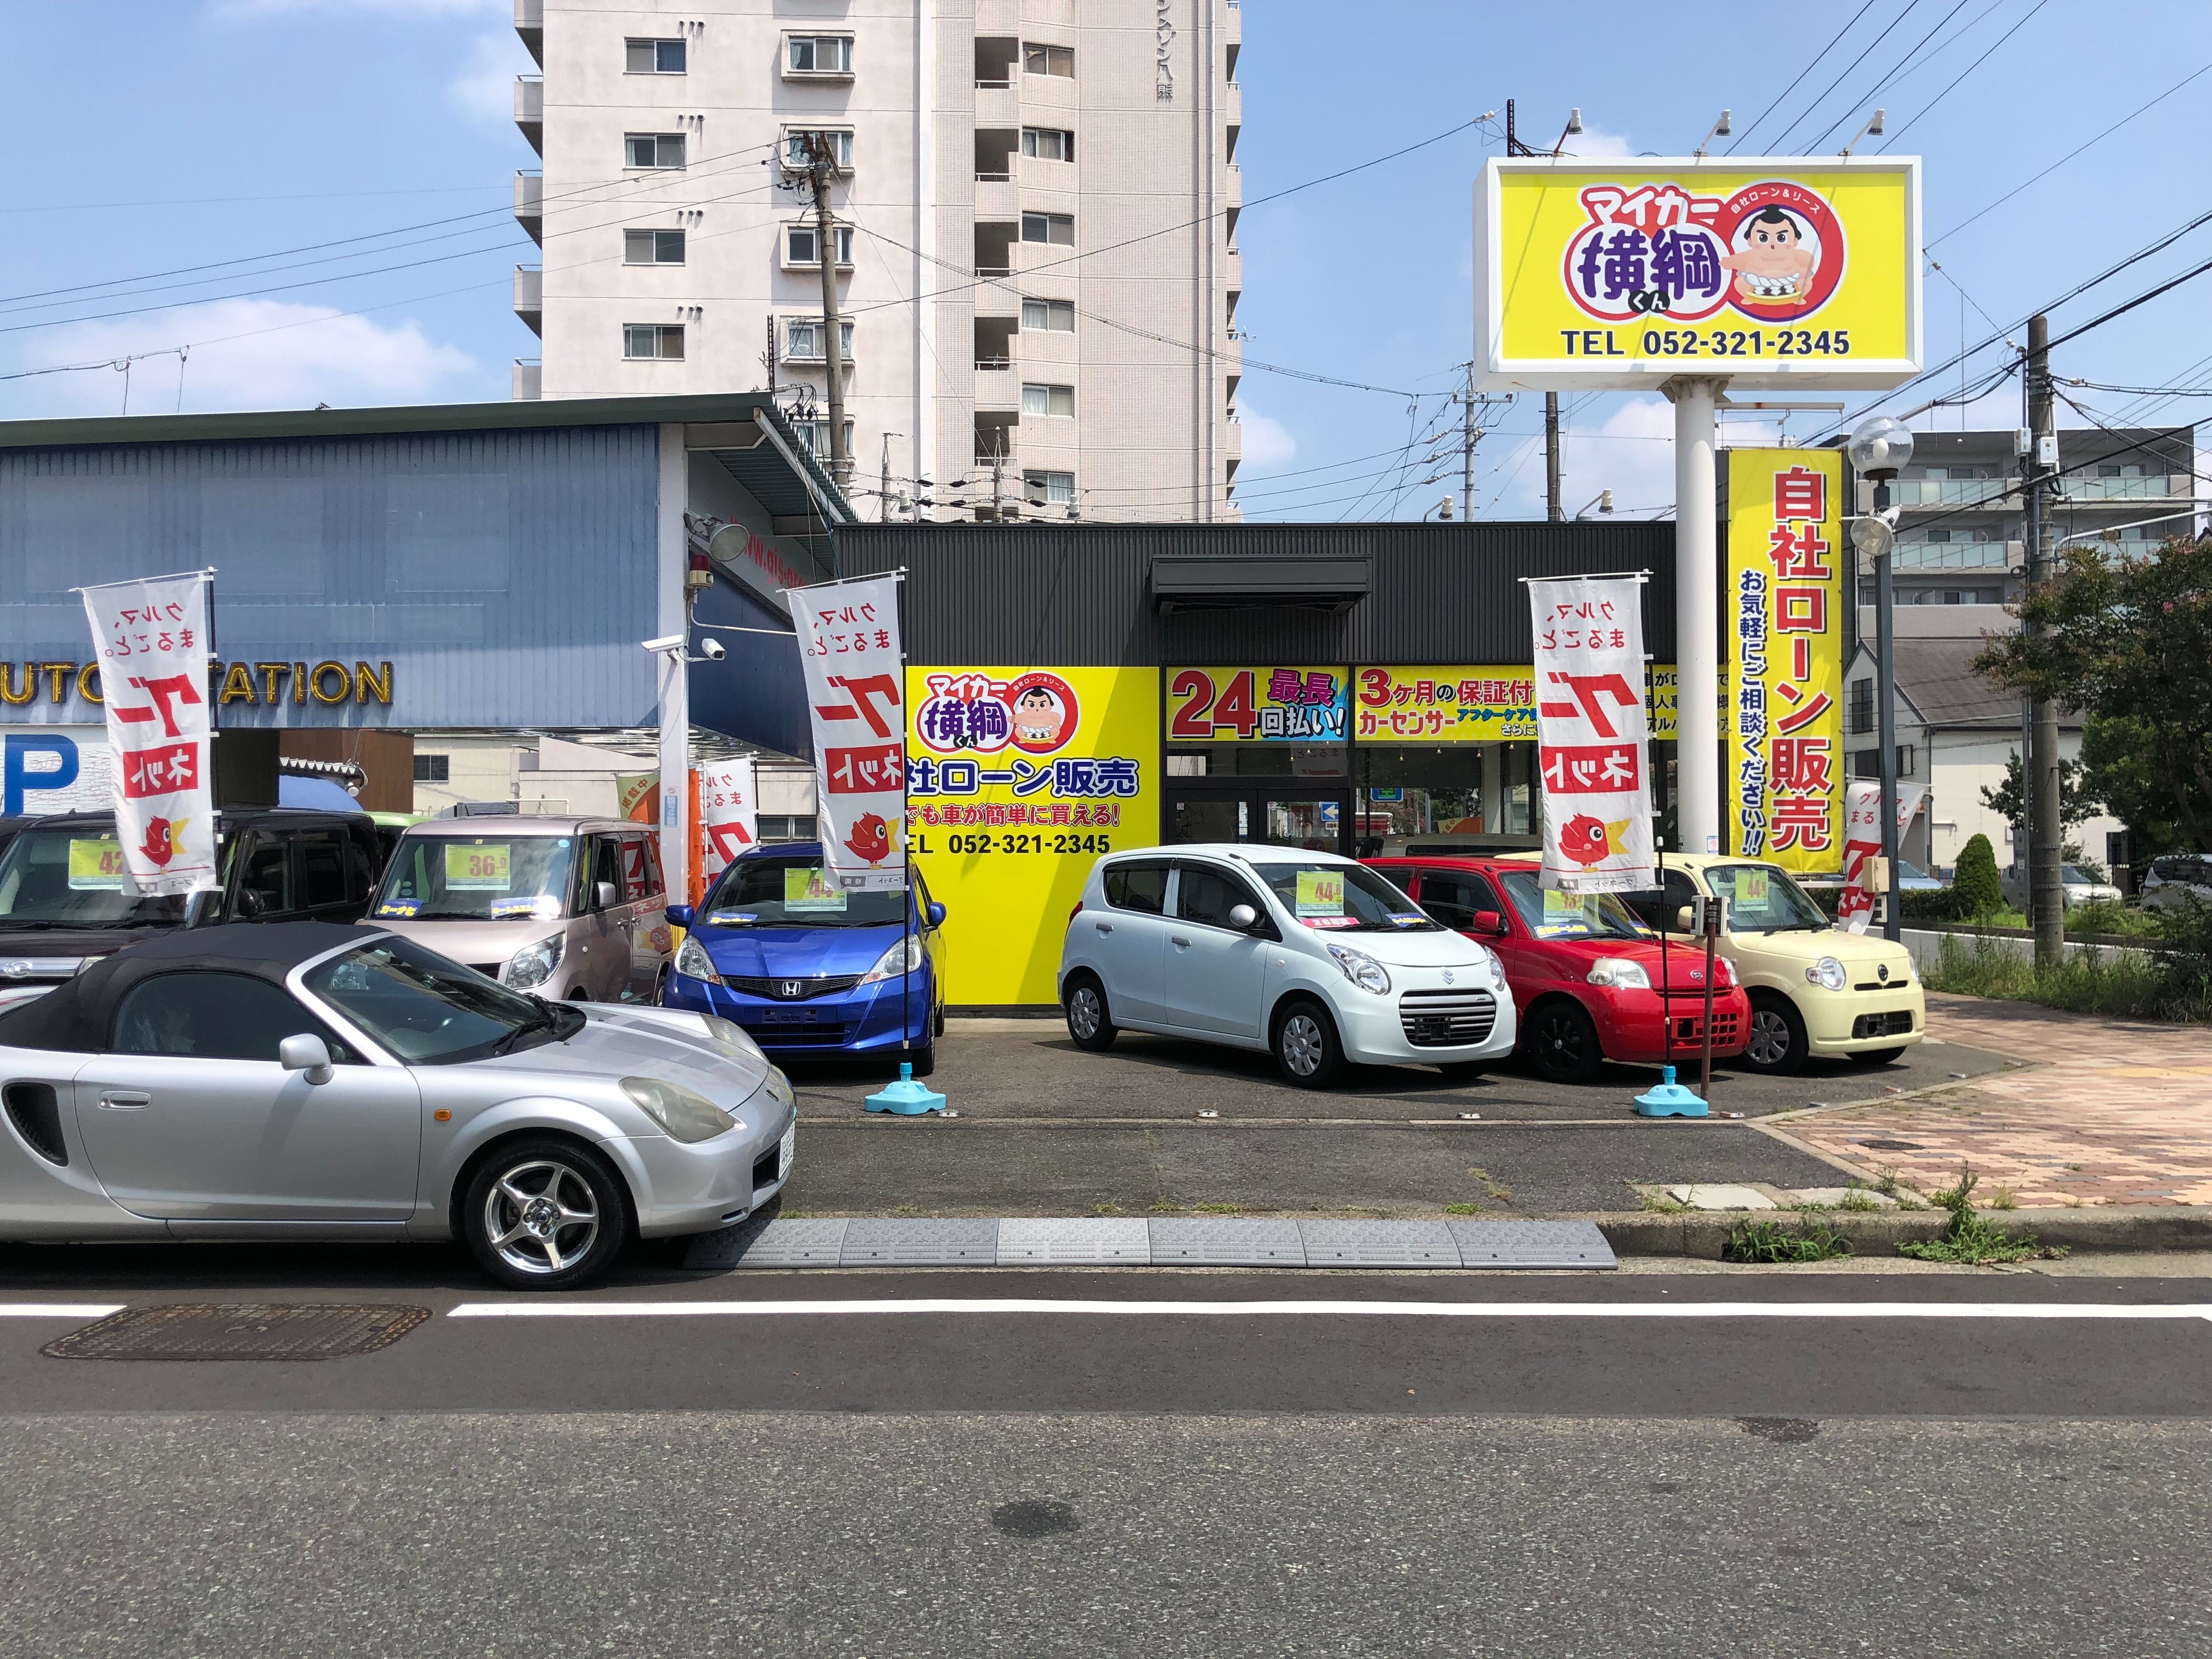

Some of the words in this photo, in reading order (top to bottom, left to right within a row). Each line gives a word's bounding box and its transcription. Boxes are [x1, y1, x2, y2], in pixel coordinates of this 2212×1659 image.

[1587, 188, 1720, 227] マイカー
[1578, 229, 1722, 301] 横綱
[1632, 291, 1668, 311] くん
[1561, 331, 1624, 356] TEL
[1644, 330, 1850, 356] 052-321-2345
[1771, 468, 1830, 849] 自社ローン販売
[930, 676, 1007, 698] マイカー
[1172, 670, 1257, 735] 24
[1268, 669, 1333, 707] 最長
[1359, 669, 1536, 706] 3ヶ月の保証付
[924, 699, 1008, 741] 横綱
[1262, 707, 1344, 736] 回払い!
[1359, 710, 1455, 735] カーセンサー
[5, 734, 79, 816] P
[949, 834, 1110, 854] 052-321-2345
